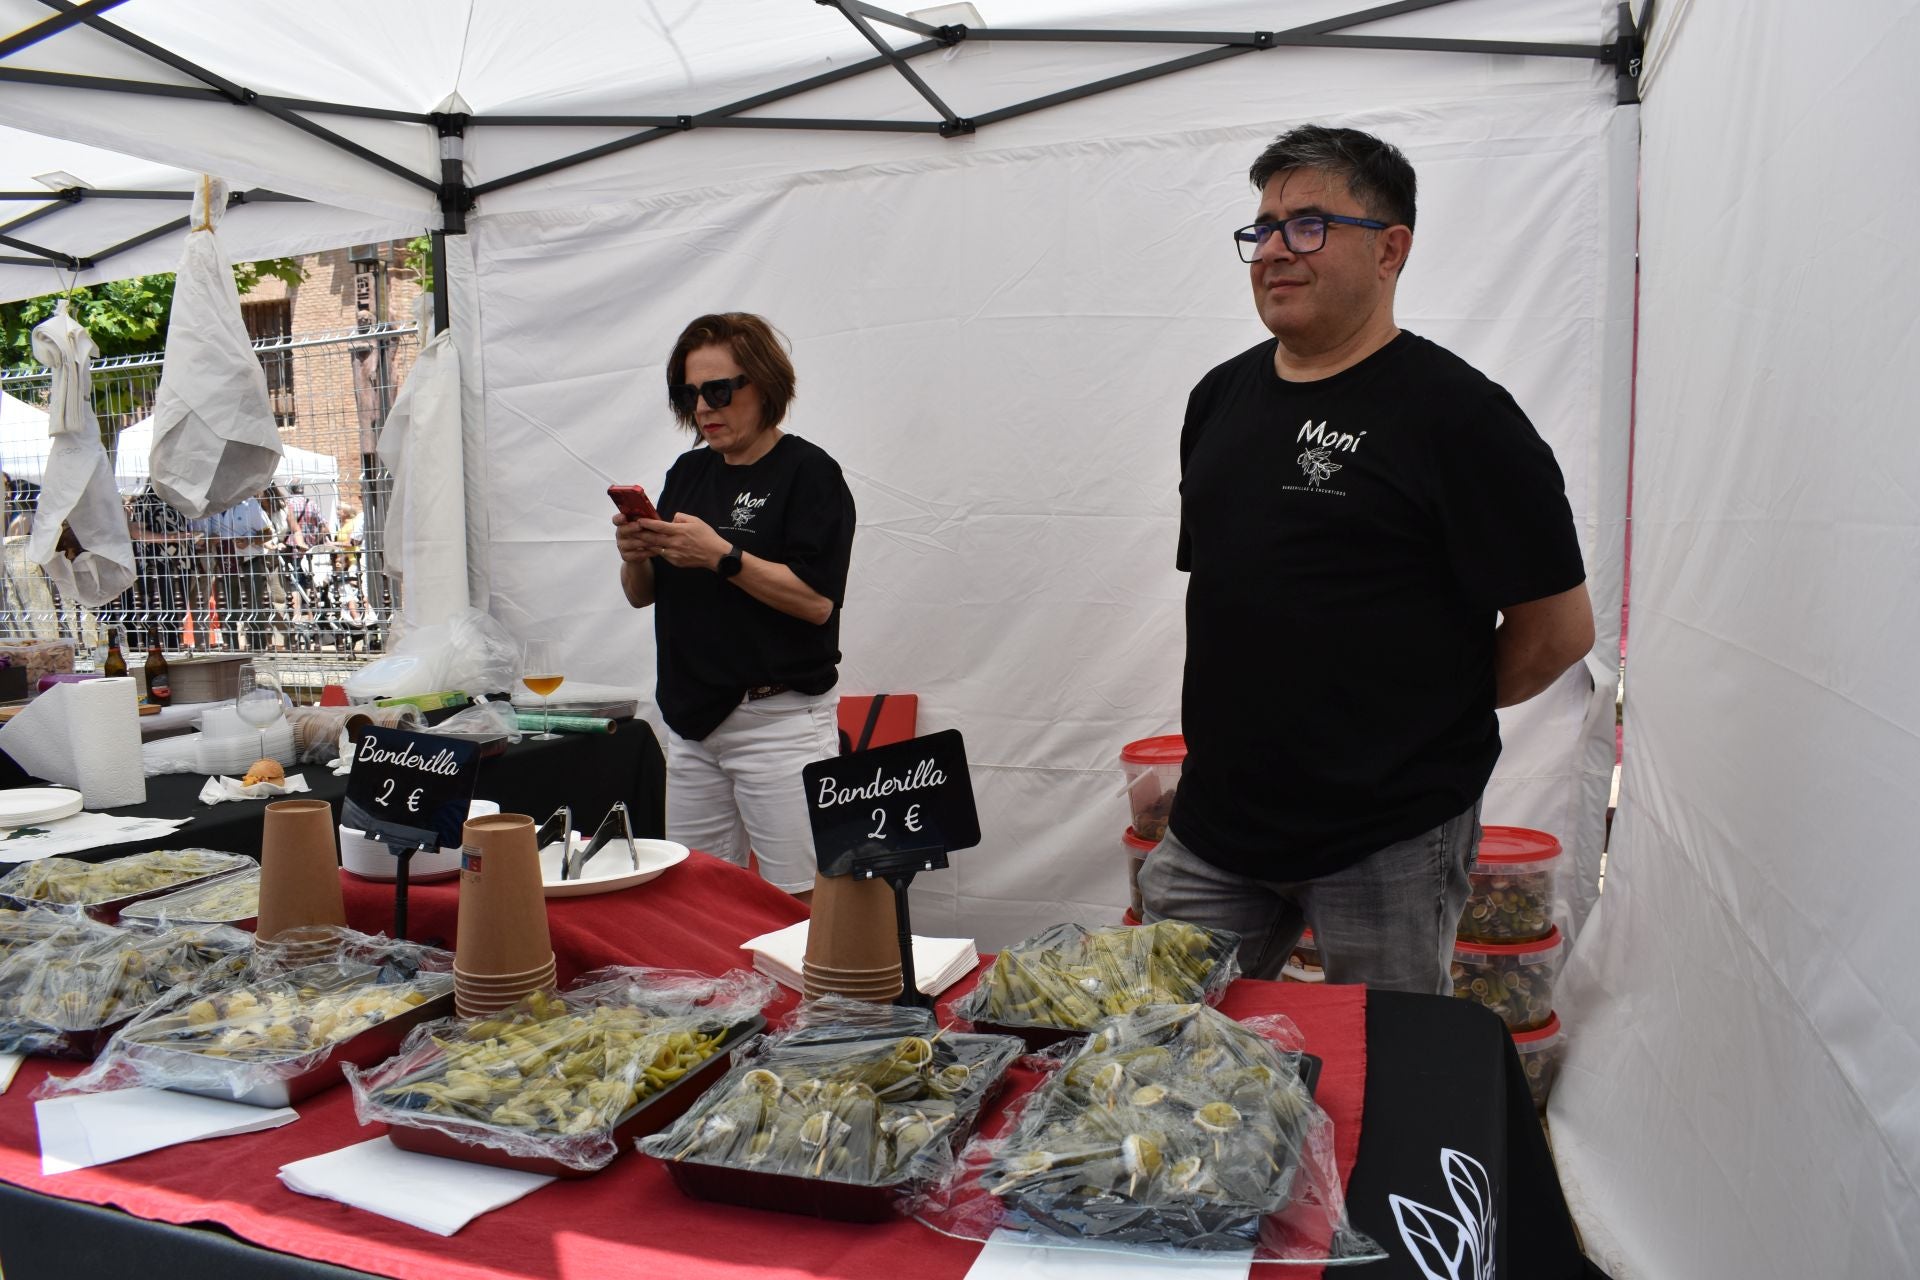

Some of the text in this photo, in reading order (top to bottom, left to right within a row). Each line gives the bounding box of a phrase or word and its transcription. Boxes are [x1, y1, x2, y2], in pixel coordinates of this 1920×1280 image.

[358, 735, 460, 775] Banderilla
[375, 778, 424, 812] 2 €
[817, 757, 948, 809] Banderilla
[867, 803, 923, 840] 2 €
